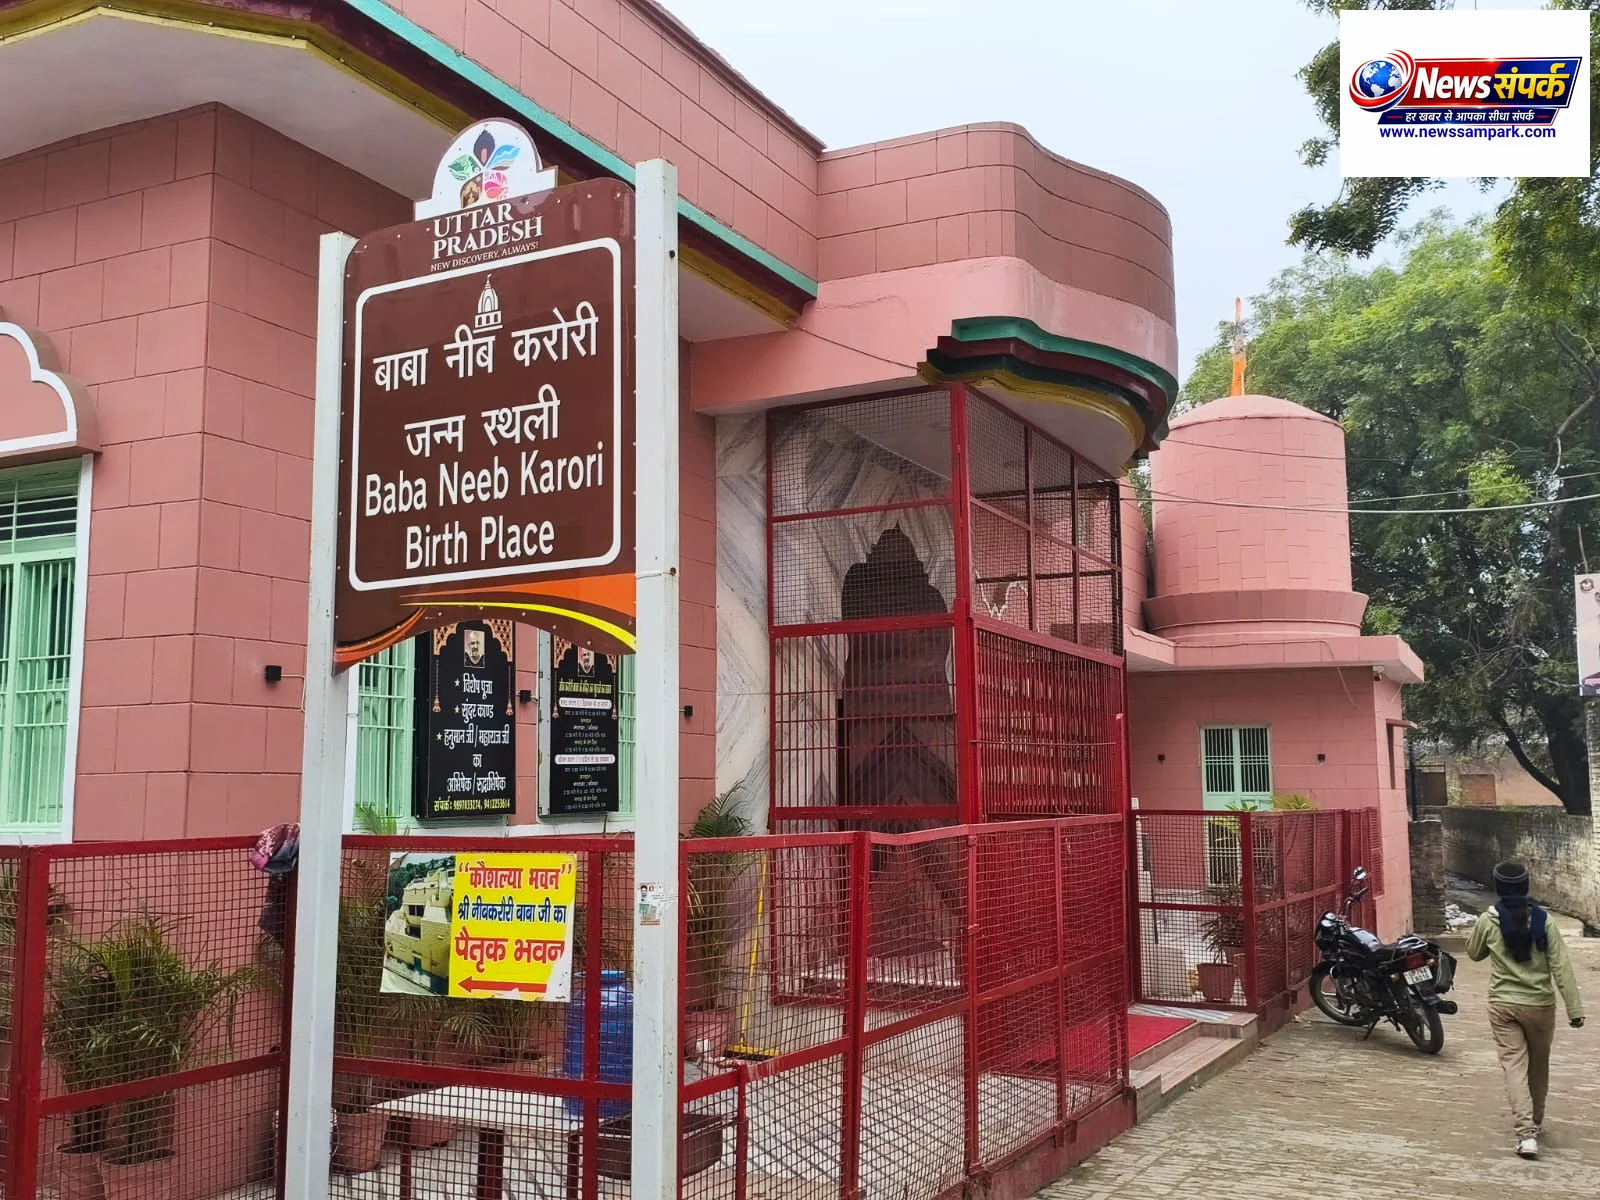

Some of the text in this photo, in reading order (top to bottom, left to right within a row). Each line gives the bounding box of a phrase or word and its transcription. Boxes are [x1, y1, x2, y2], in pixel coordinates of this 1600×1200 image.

[432, 216, 543, 260] PRADESH
[434, 203, 514, 238] UTTAR
[430, 241, 539, 272] NEW DISCOVERY, ALWAYS!
[373, 300, 599, 392] बाबा नीब करोरी
[404, 384, 561, 457] जन्म स्थली
[366, 441, 603, 517] Baba Neeb Karori
[406, 515, 555, 570] Birth Place
[472, 754, 482, 768] का
[458, 895, 469, 920] श्री
[538, 897, 551, 923] जी
[553, 905, 567, 923] का
[454, 925, 565, 973] पैतृक भवन
